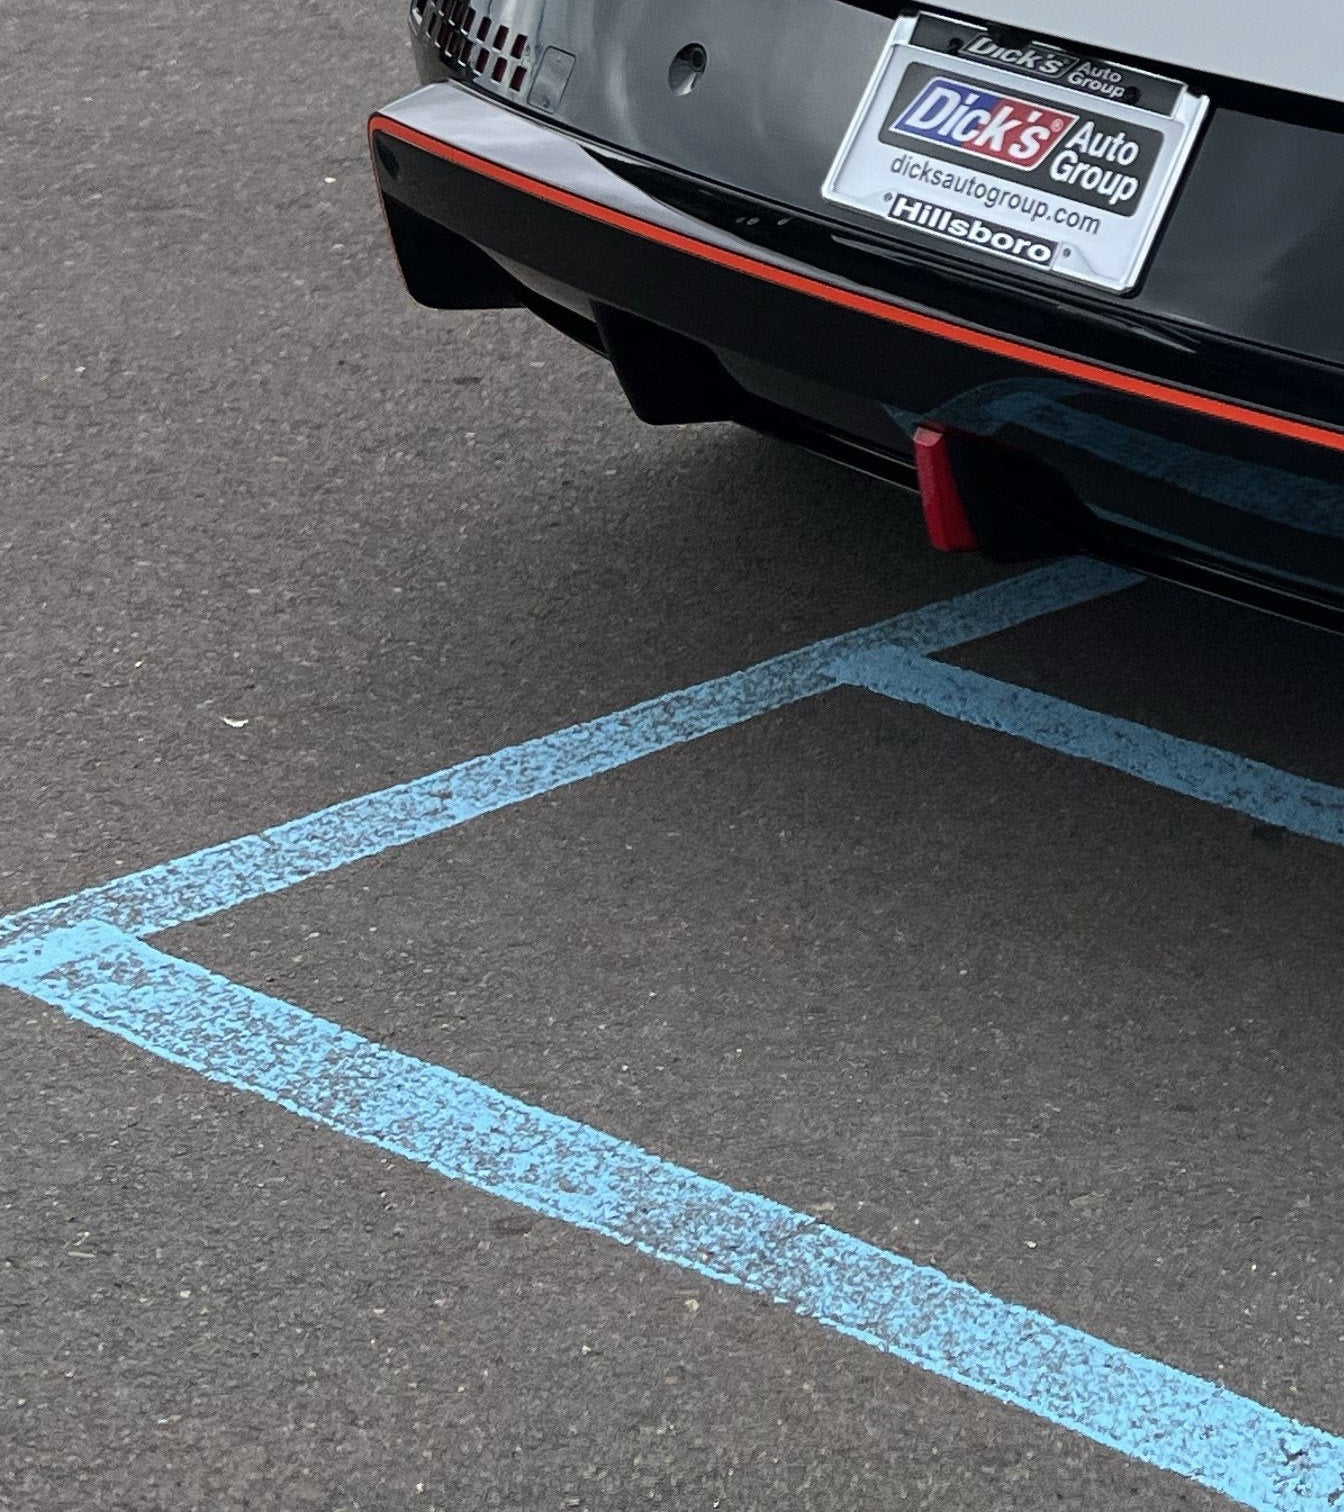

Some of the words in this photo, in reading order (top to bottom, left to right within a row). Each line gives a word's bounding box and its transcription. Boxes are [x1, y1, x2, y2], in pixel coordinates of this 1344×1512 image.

[1068, 72, 1126, 99] Group
[1078, 60, 1124, 83] Auto
[905, 84, 1051, 161] Dick's
[1066, 120, 1140, 167] Auto
[889, 152, 1102, 236] dicksautogroup.com
[1049, 154, 1140, 206] Group
[891, 195, 1053, 265] Hillsboro
